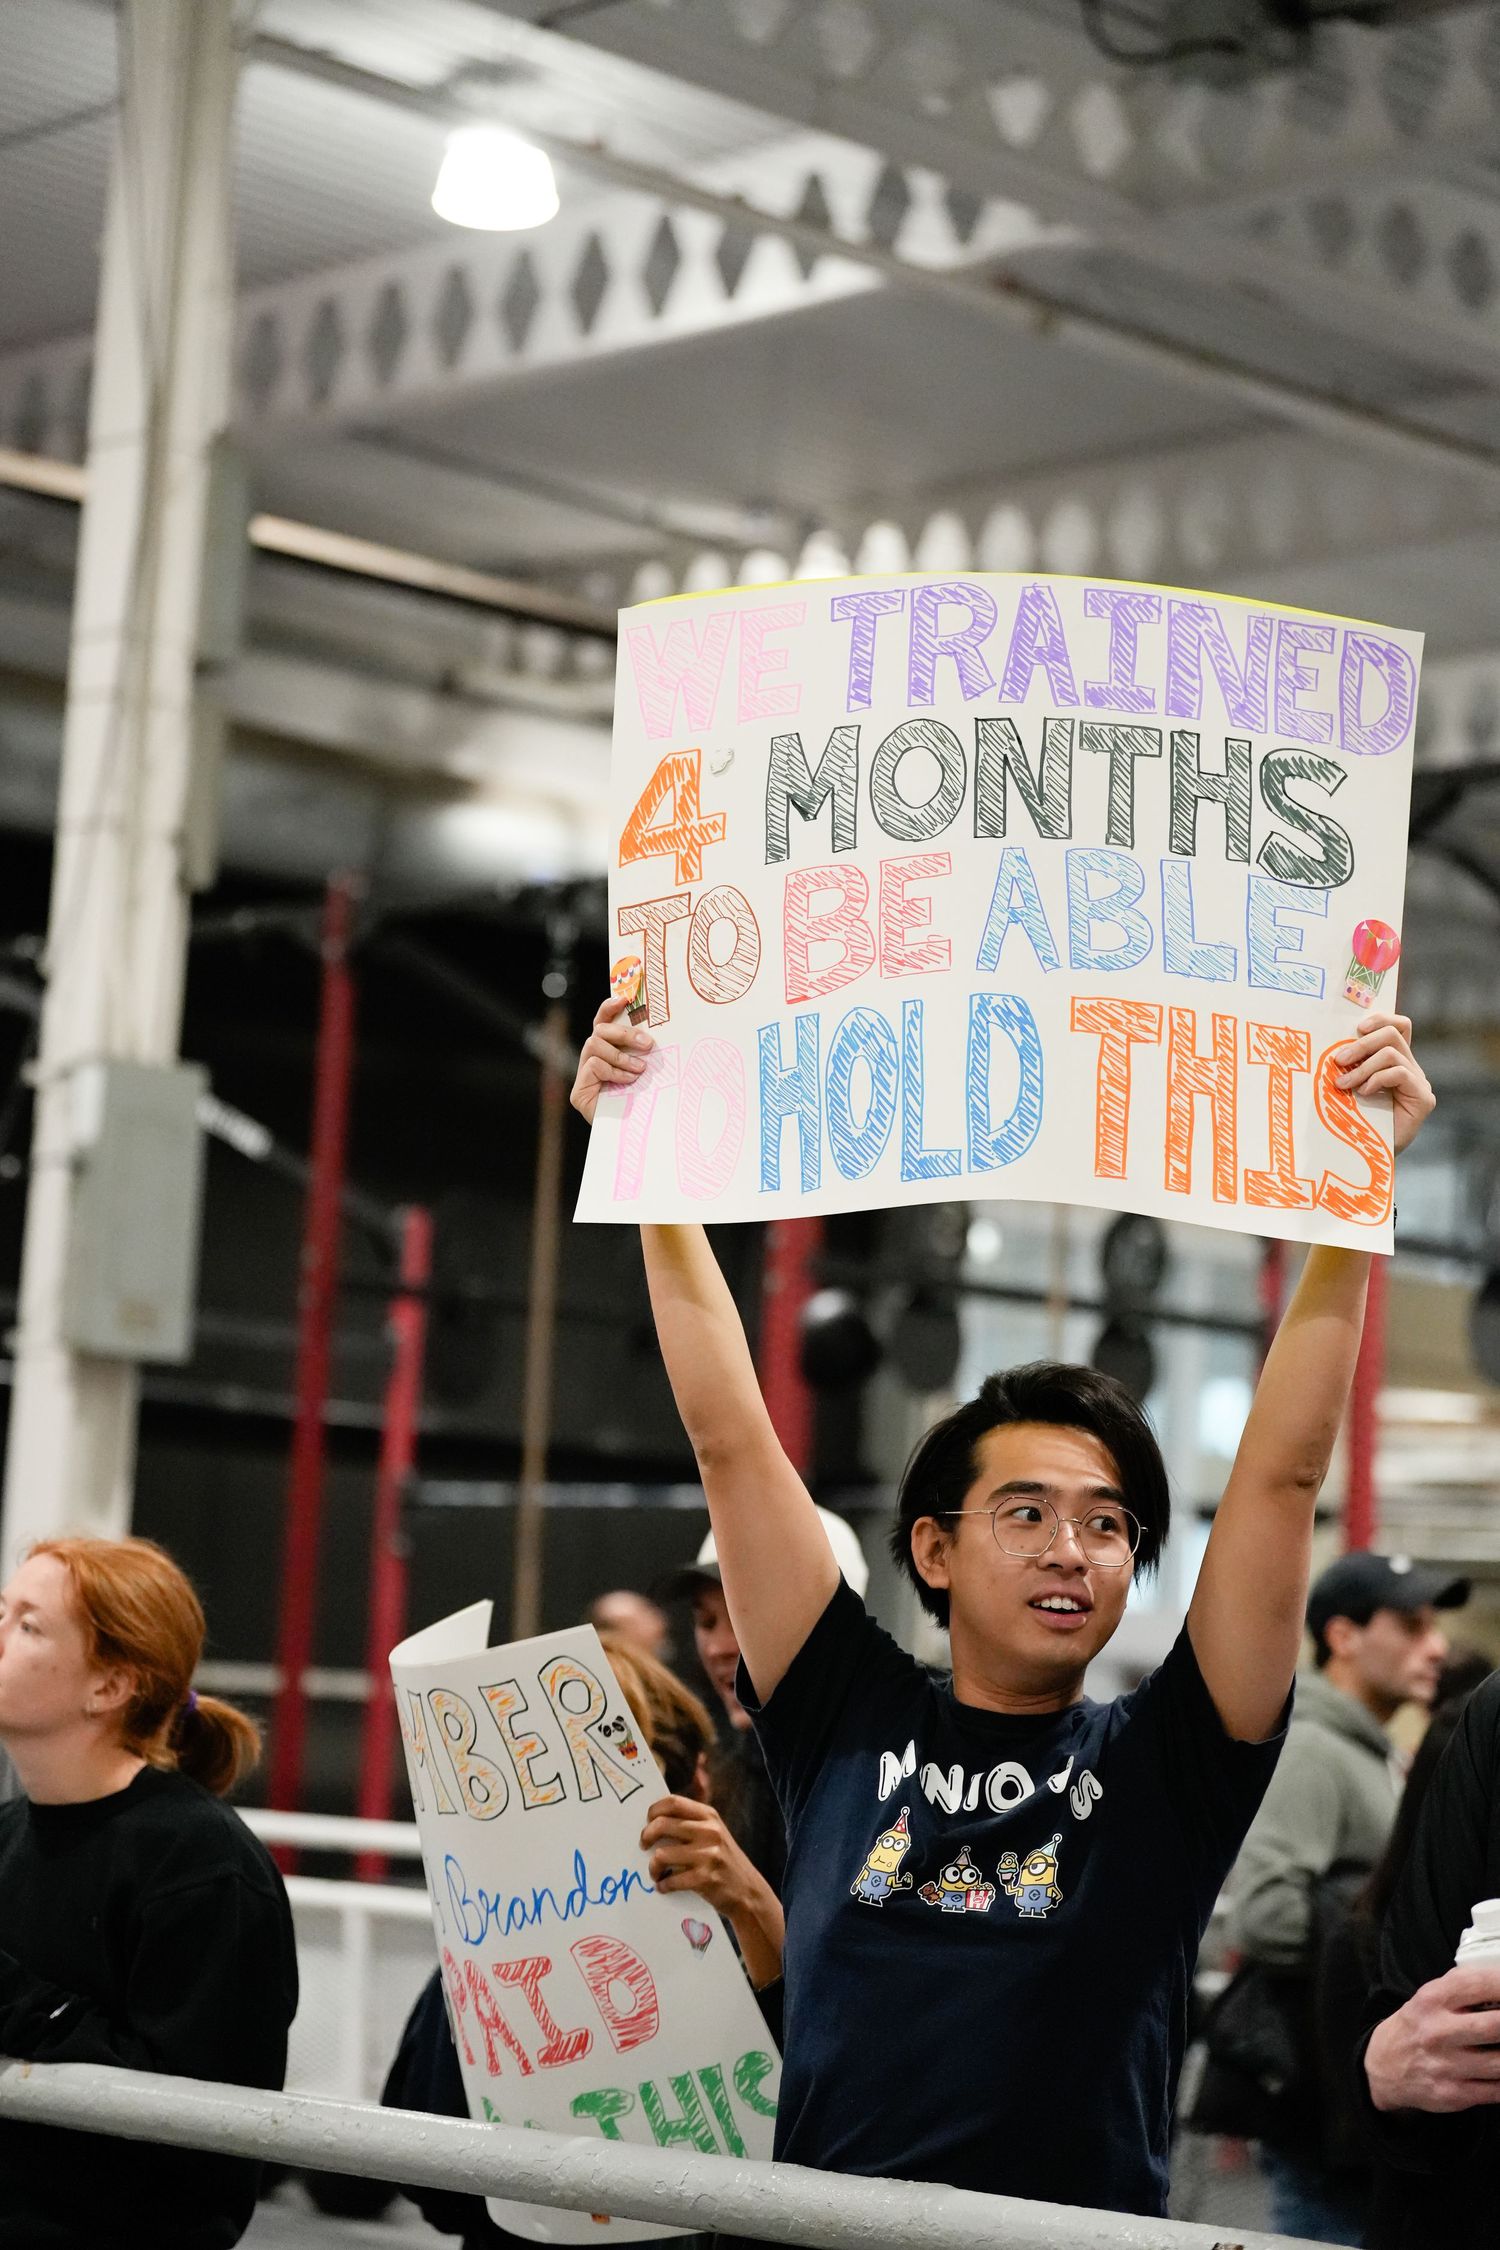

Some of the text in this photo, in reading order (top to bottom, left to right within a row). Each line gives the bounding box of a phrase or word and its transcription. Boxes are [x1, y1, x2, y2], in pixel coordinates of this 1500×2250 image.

[625, 581, 1417, 756] WE TRAINED
[619, 718, 1355, 890] 4 MONTHS
[617, 847, 1332, 1028] TO BE ABLE
[607, 992, 1393, 1226] TO HOLD THIS
[444, 1848, 655, 1946] Brandon
